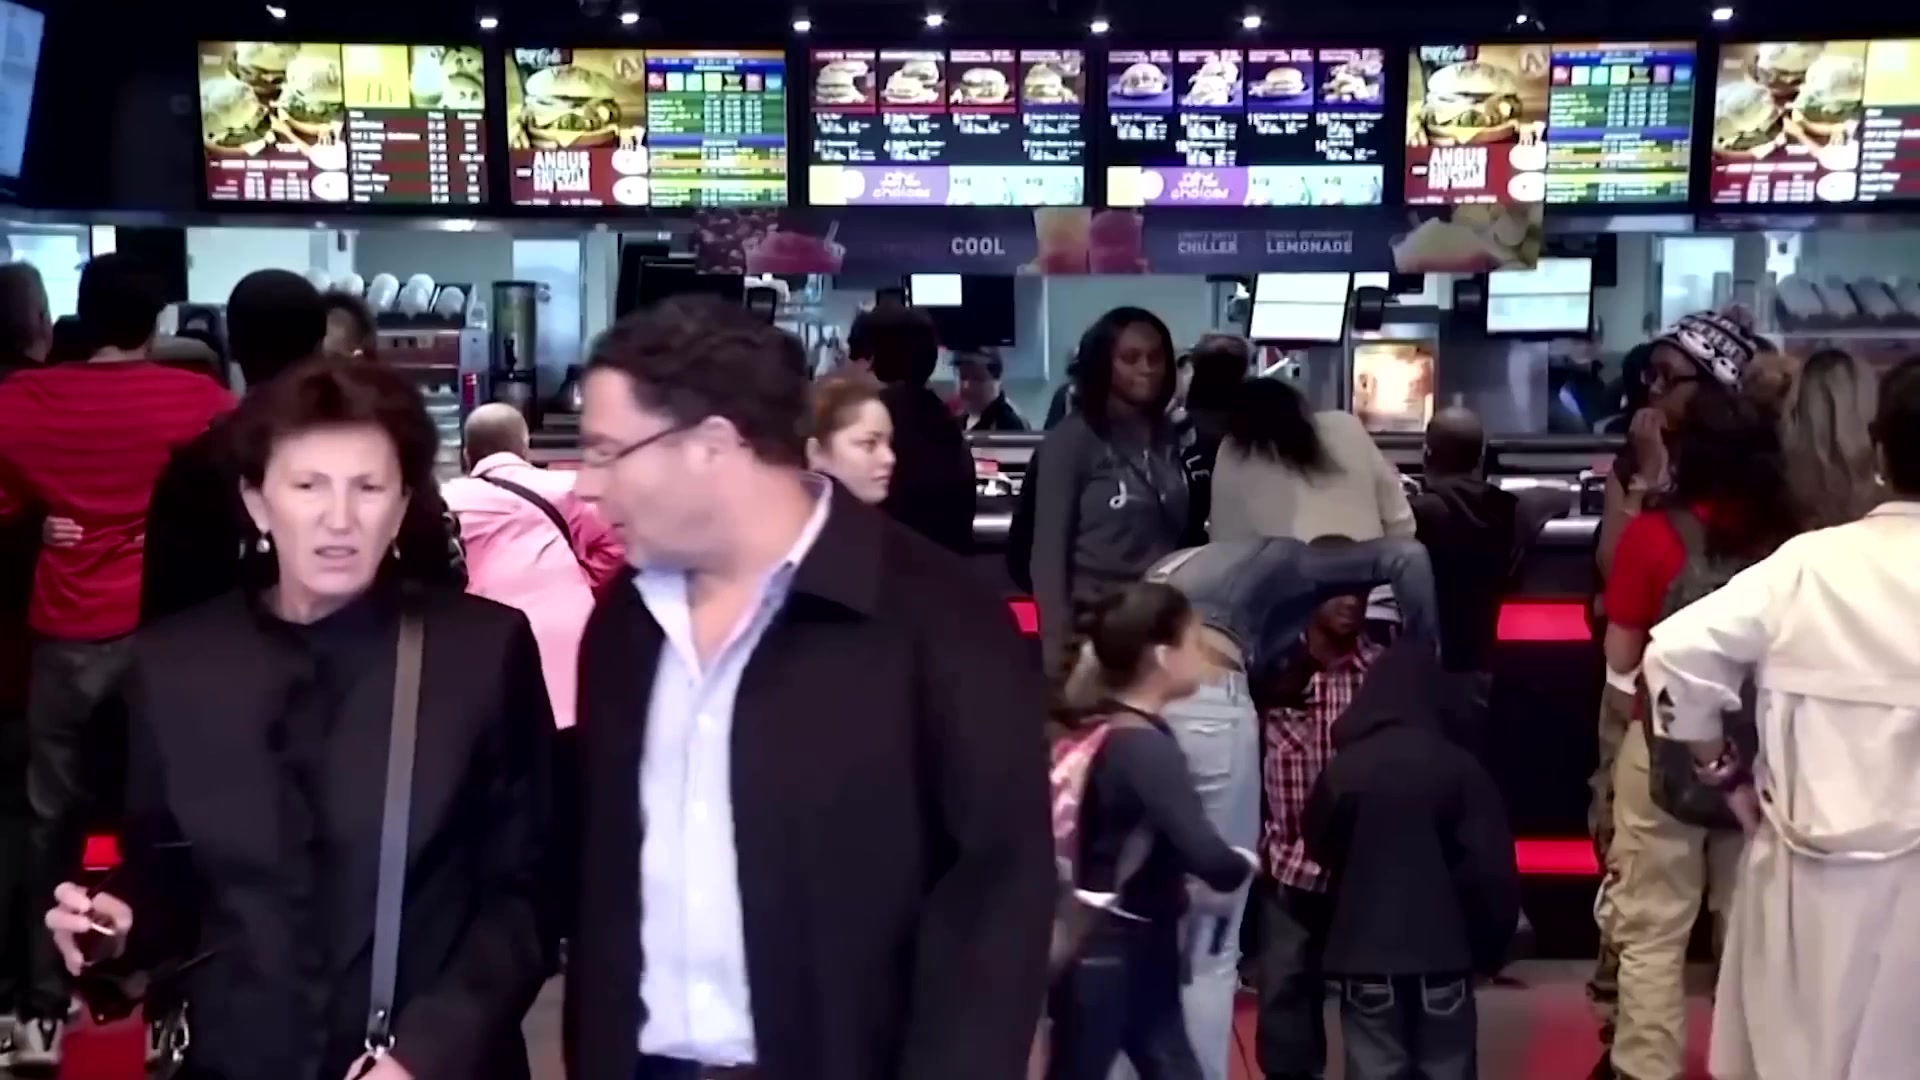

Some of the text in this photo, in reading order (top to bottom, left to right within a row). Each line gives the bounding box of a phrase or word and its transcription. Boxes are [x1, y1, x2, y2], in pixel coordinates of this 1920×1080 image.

[951, 237, 1006, 255] COOL
[1178, 241, 1238, 254] CHILLER
[1266, 241, 1353, 254] LEMONADE
